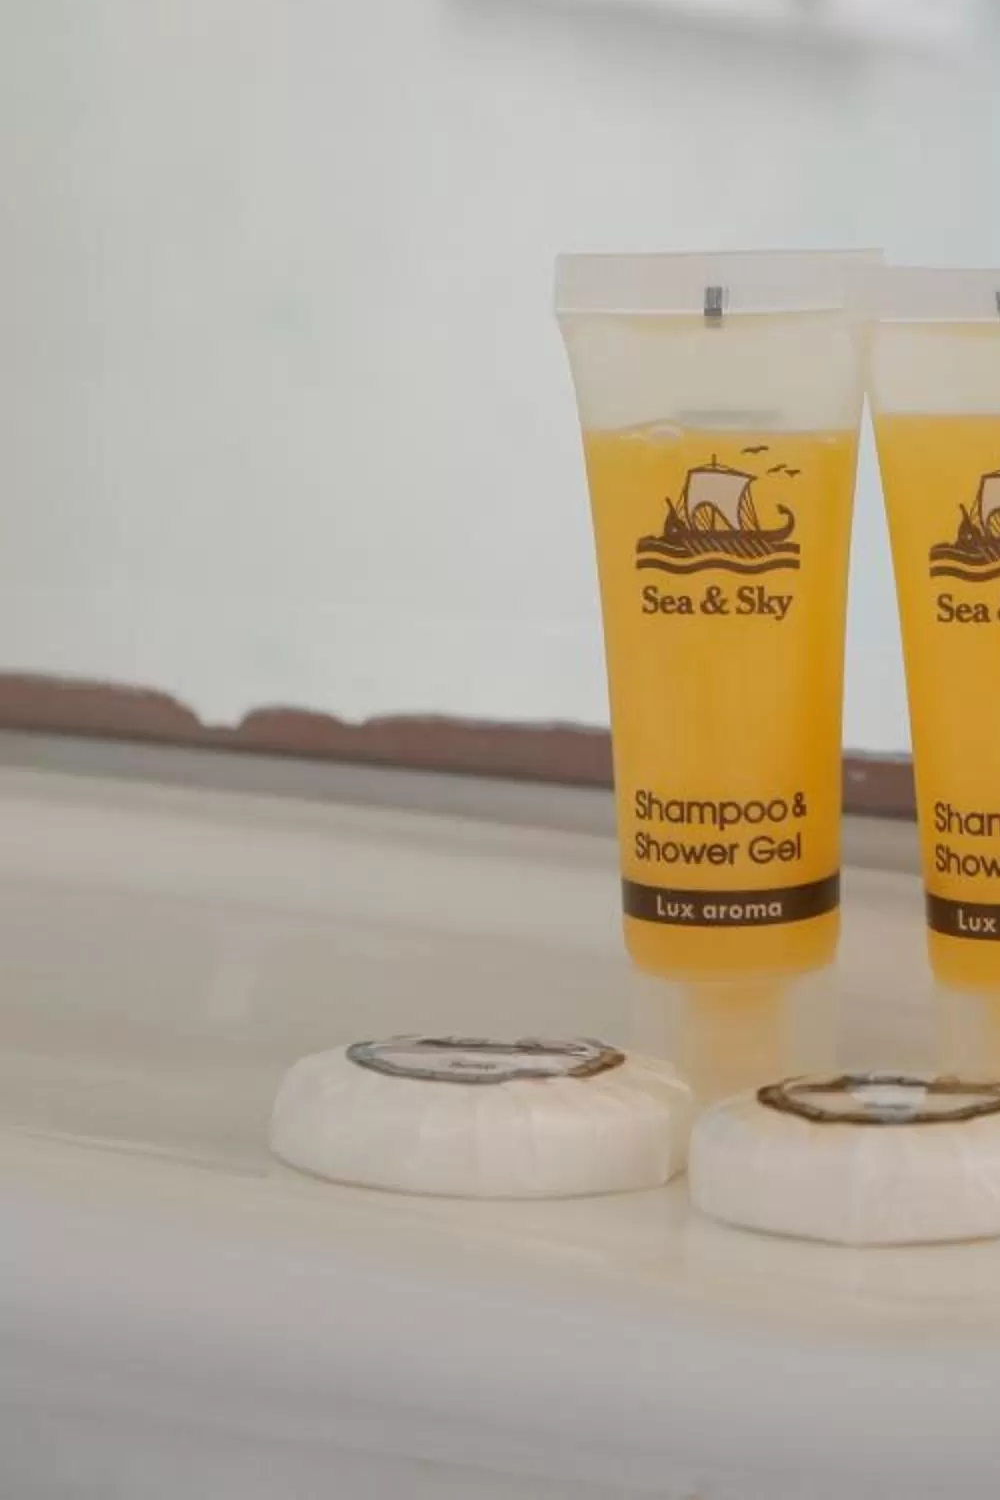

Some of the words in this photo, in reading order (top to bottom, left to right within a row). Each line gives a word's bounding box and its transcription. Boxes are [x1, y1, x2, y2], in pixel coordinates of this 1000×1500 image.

[642, 585, 694, 615] Sea
[700, 585, 729, 615] &
[736, 585, 793, 621] Sky
[937, 593, 991, 623] Sea
[635, 789, 788, 831] Shampoo
[792, 791, 807, 818] &
[635, 831, 740, 865] Shower
[748, 831, 802, 864] Gel
[656, 894, 695, 920] Lux
[702, 901, 783, 920] aroma
[957, 908, 997, 933] Lux
